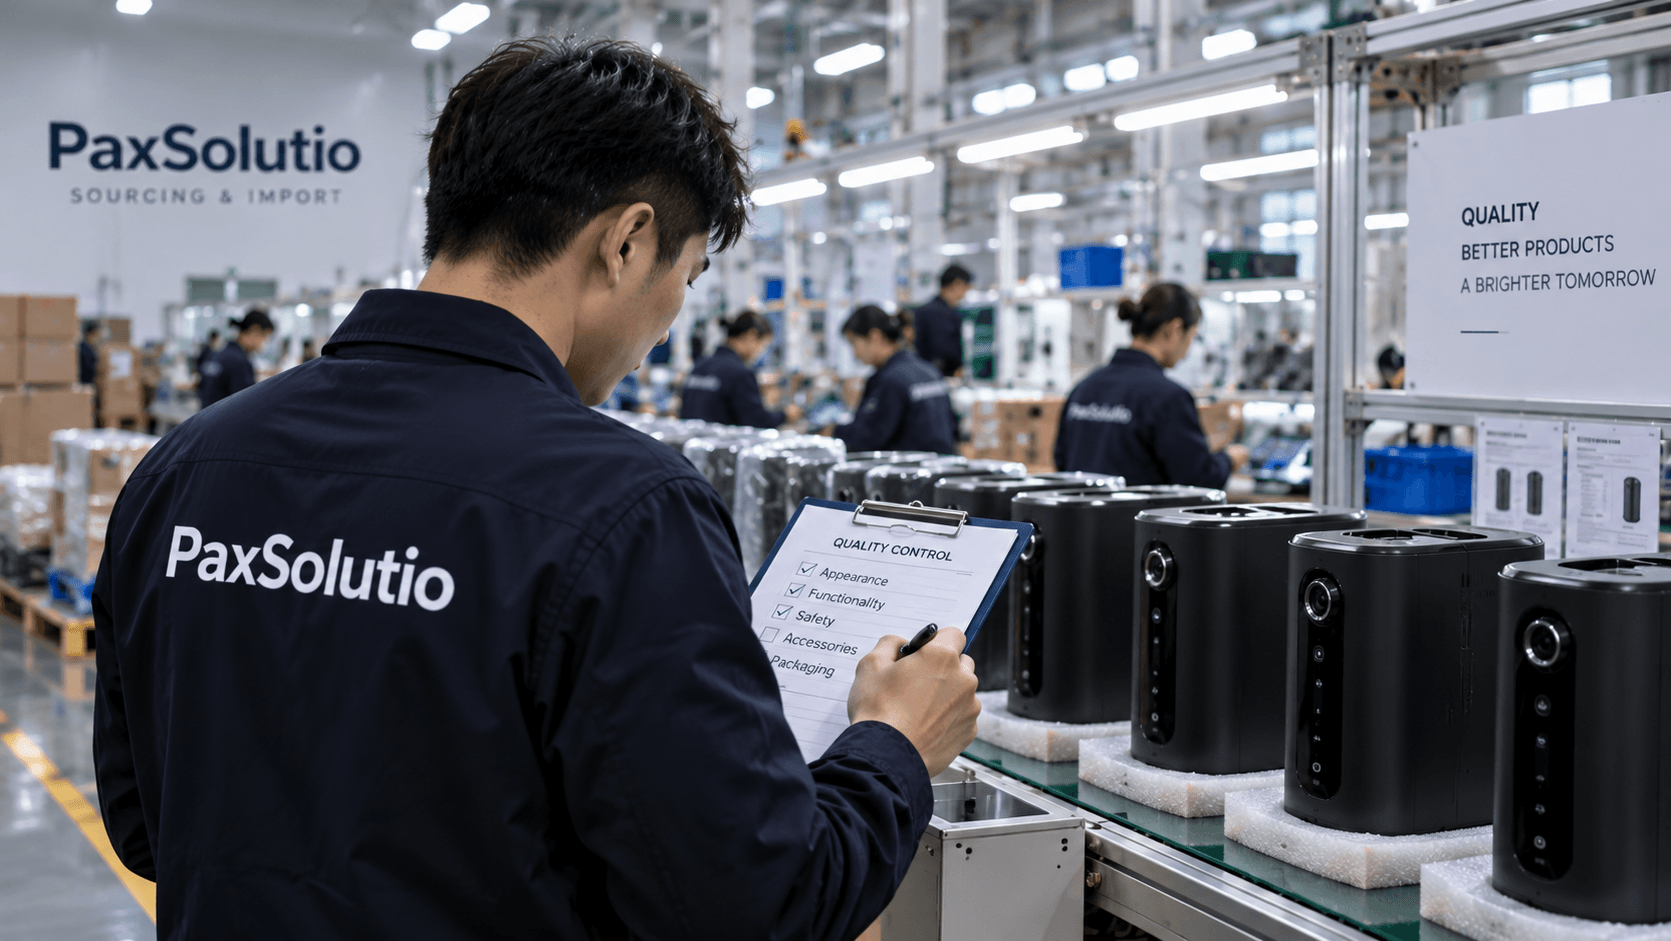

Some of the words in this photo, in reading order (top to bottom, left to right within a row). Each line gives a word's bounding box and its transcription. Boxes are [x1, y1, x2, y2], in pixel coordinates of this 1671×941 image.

[48, 121, 362, 174] PaxSolutio
[70, 187, 205, 205] SOURCING
[219, 188, 233, 205] &
[249, 188, 342, 205] IMPORT
[1461, 201, 1540, 227] QUALITY
[1461, 241, 1520, 260] BETTER
[1525, 234, 1614, 257] PRODUCTS
[1460, 277, 1471, 294] A
[1475, 274, 1550, 293] BRIGHTER
[1555, 268, 1656, 290] TOMORROW
[833, 537, 890, 553] QUALITY
[890, 545, 953, 562] CONTROL
[165, 525, 455, 612] PaxSolutio
[819, 567, 889, 587] Appearance
[796, 610, 836, 629] Safety
[782, 632, 859, 655] Accessories
